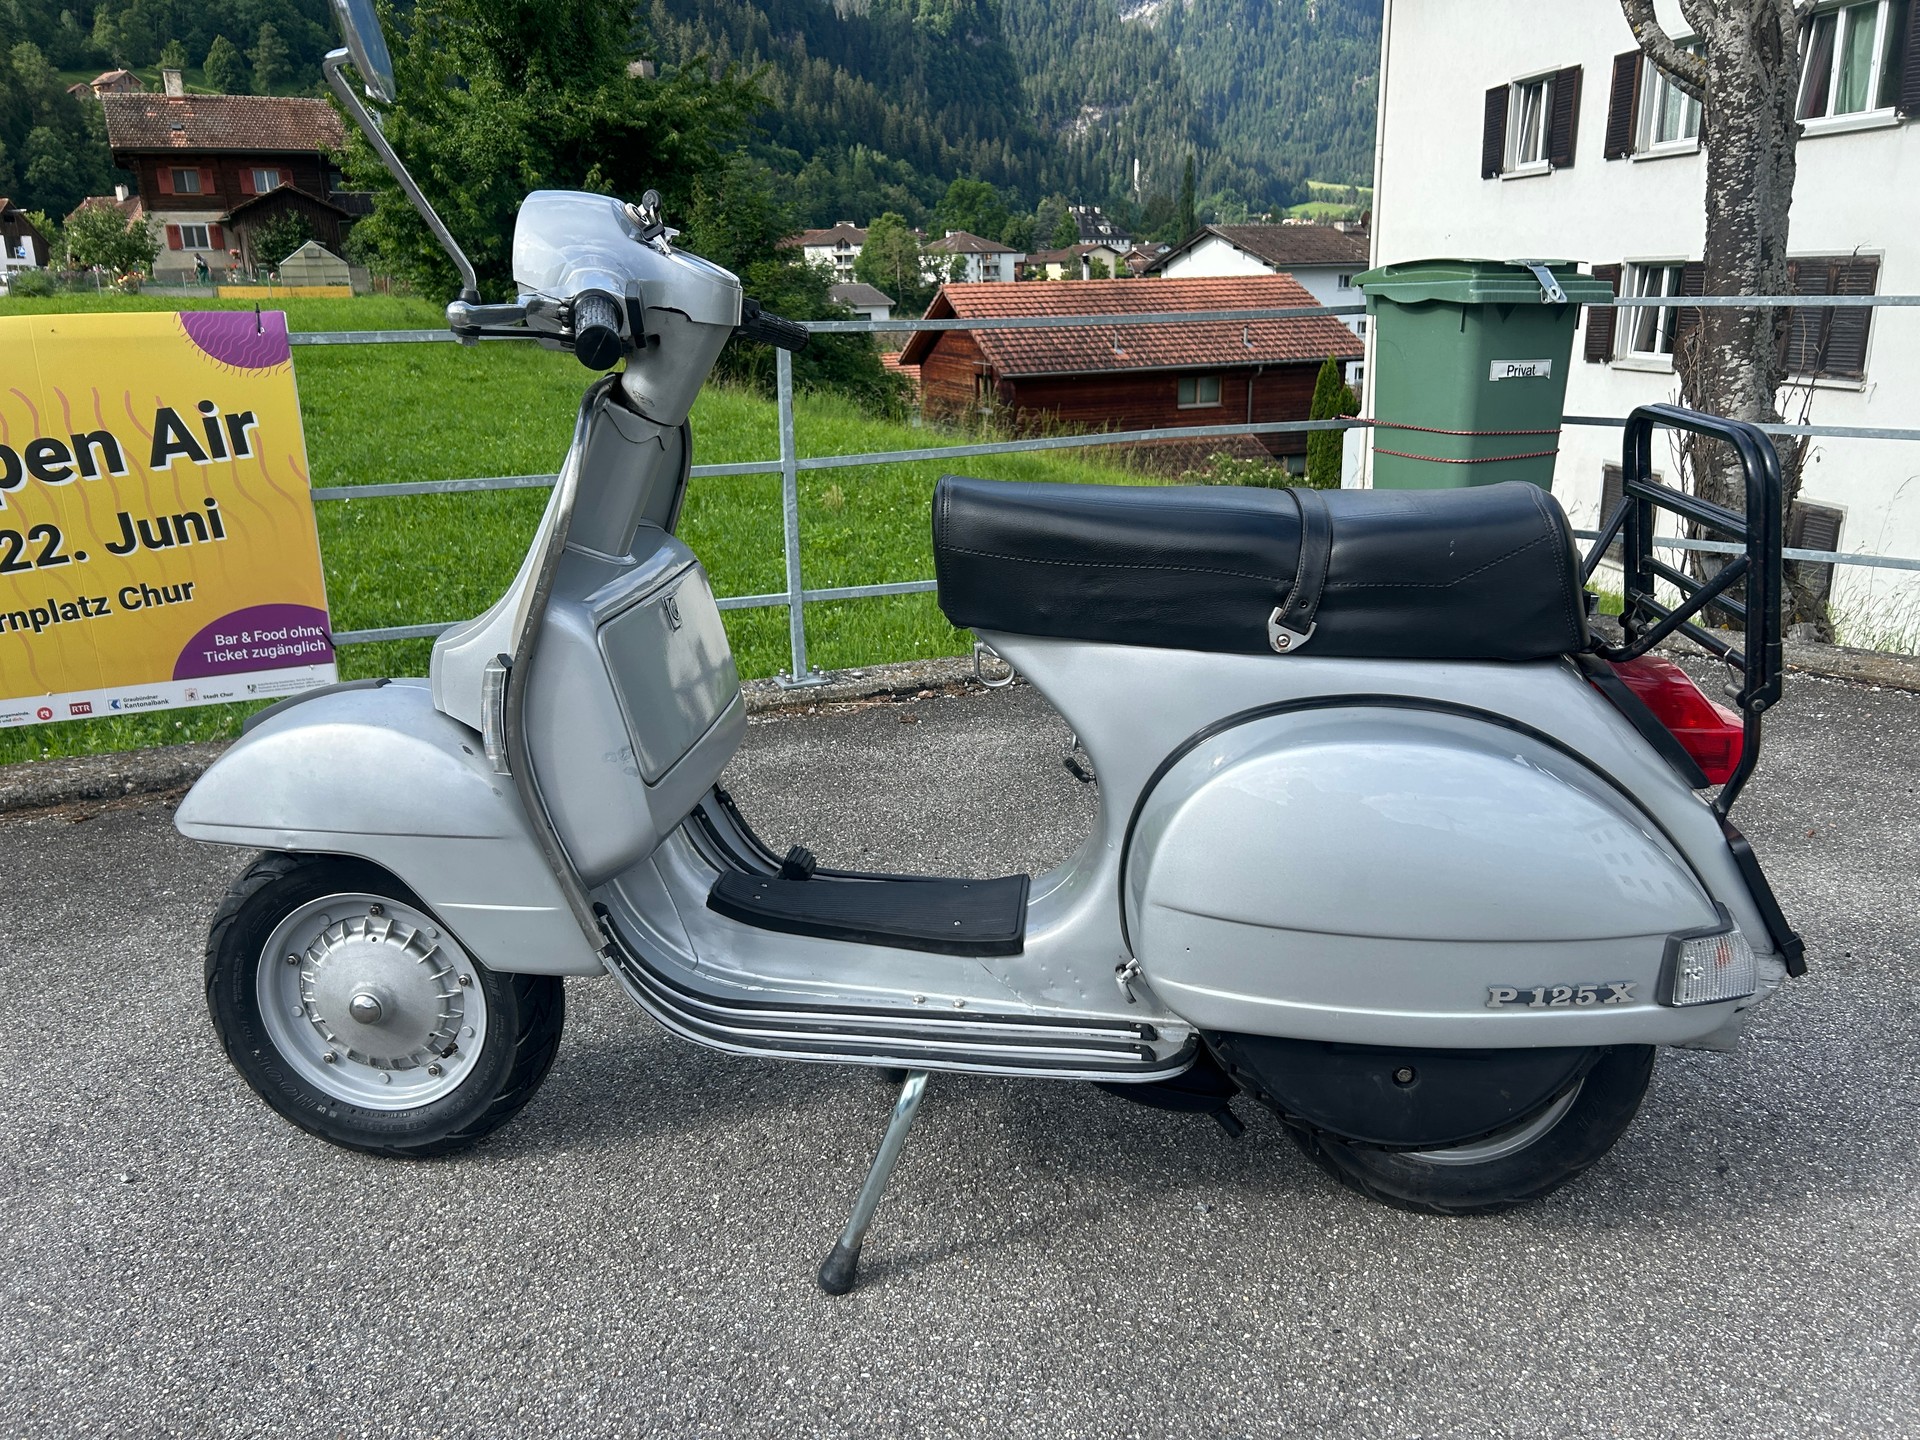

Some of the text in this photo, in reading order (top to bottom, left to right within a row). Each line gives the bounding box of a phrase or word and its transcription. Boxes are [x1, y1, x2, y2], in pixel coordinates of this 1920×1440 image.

[1507, 364, 1536, 377] Privat
[150, 399, 258, 471] Air
[0, 497, 227, 576] 22. Juni
[118, 580, 195, 611] Chur
[214, 625, 324, 646] Bar & Food ohne
[203, 639, 327, 663] Ticket zugänglich
[71, 704, 91, 714] RTR
[124, 698, 169, 709] Kantonalbank
[1486, 980, 1638, 1007] P 125 X
